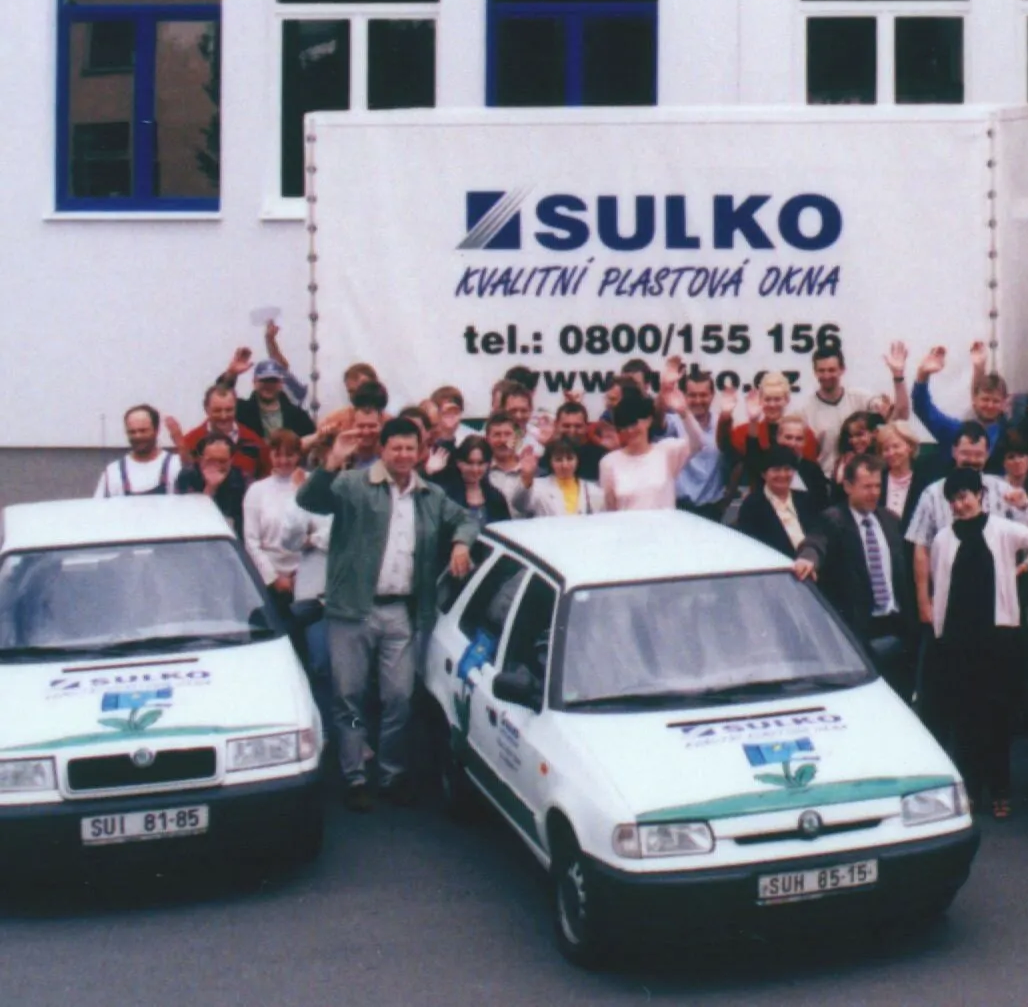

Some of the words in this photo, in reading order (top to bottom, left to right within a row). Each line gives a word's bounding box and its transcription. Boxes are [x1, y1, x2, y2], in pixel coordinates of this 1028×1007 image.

[533, 193, 843, 251] SULKO
[456, 257, 595, 298] KVALITNÍ
[597, 259, 750, 298] PLASTOVÁ
[758, 265, 840, 297] OKNA
[464, 324, 542, 355] tel.:
[559, 324, 751, 356] 0800/155
[767, 323, 841, 356] 156
[722, 715, 841, 731] SULKO
[90, 818, 126, 837] SUI
[143, 807, 200, 832] 81-85
[769, 874, 805, 894] SUH
